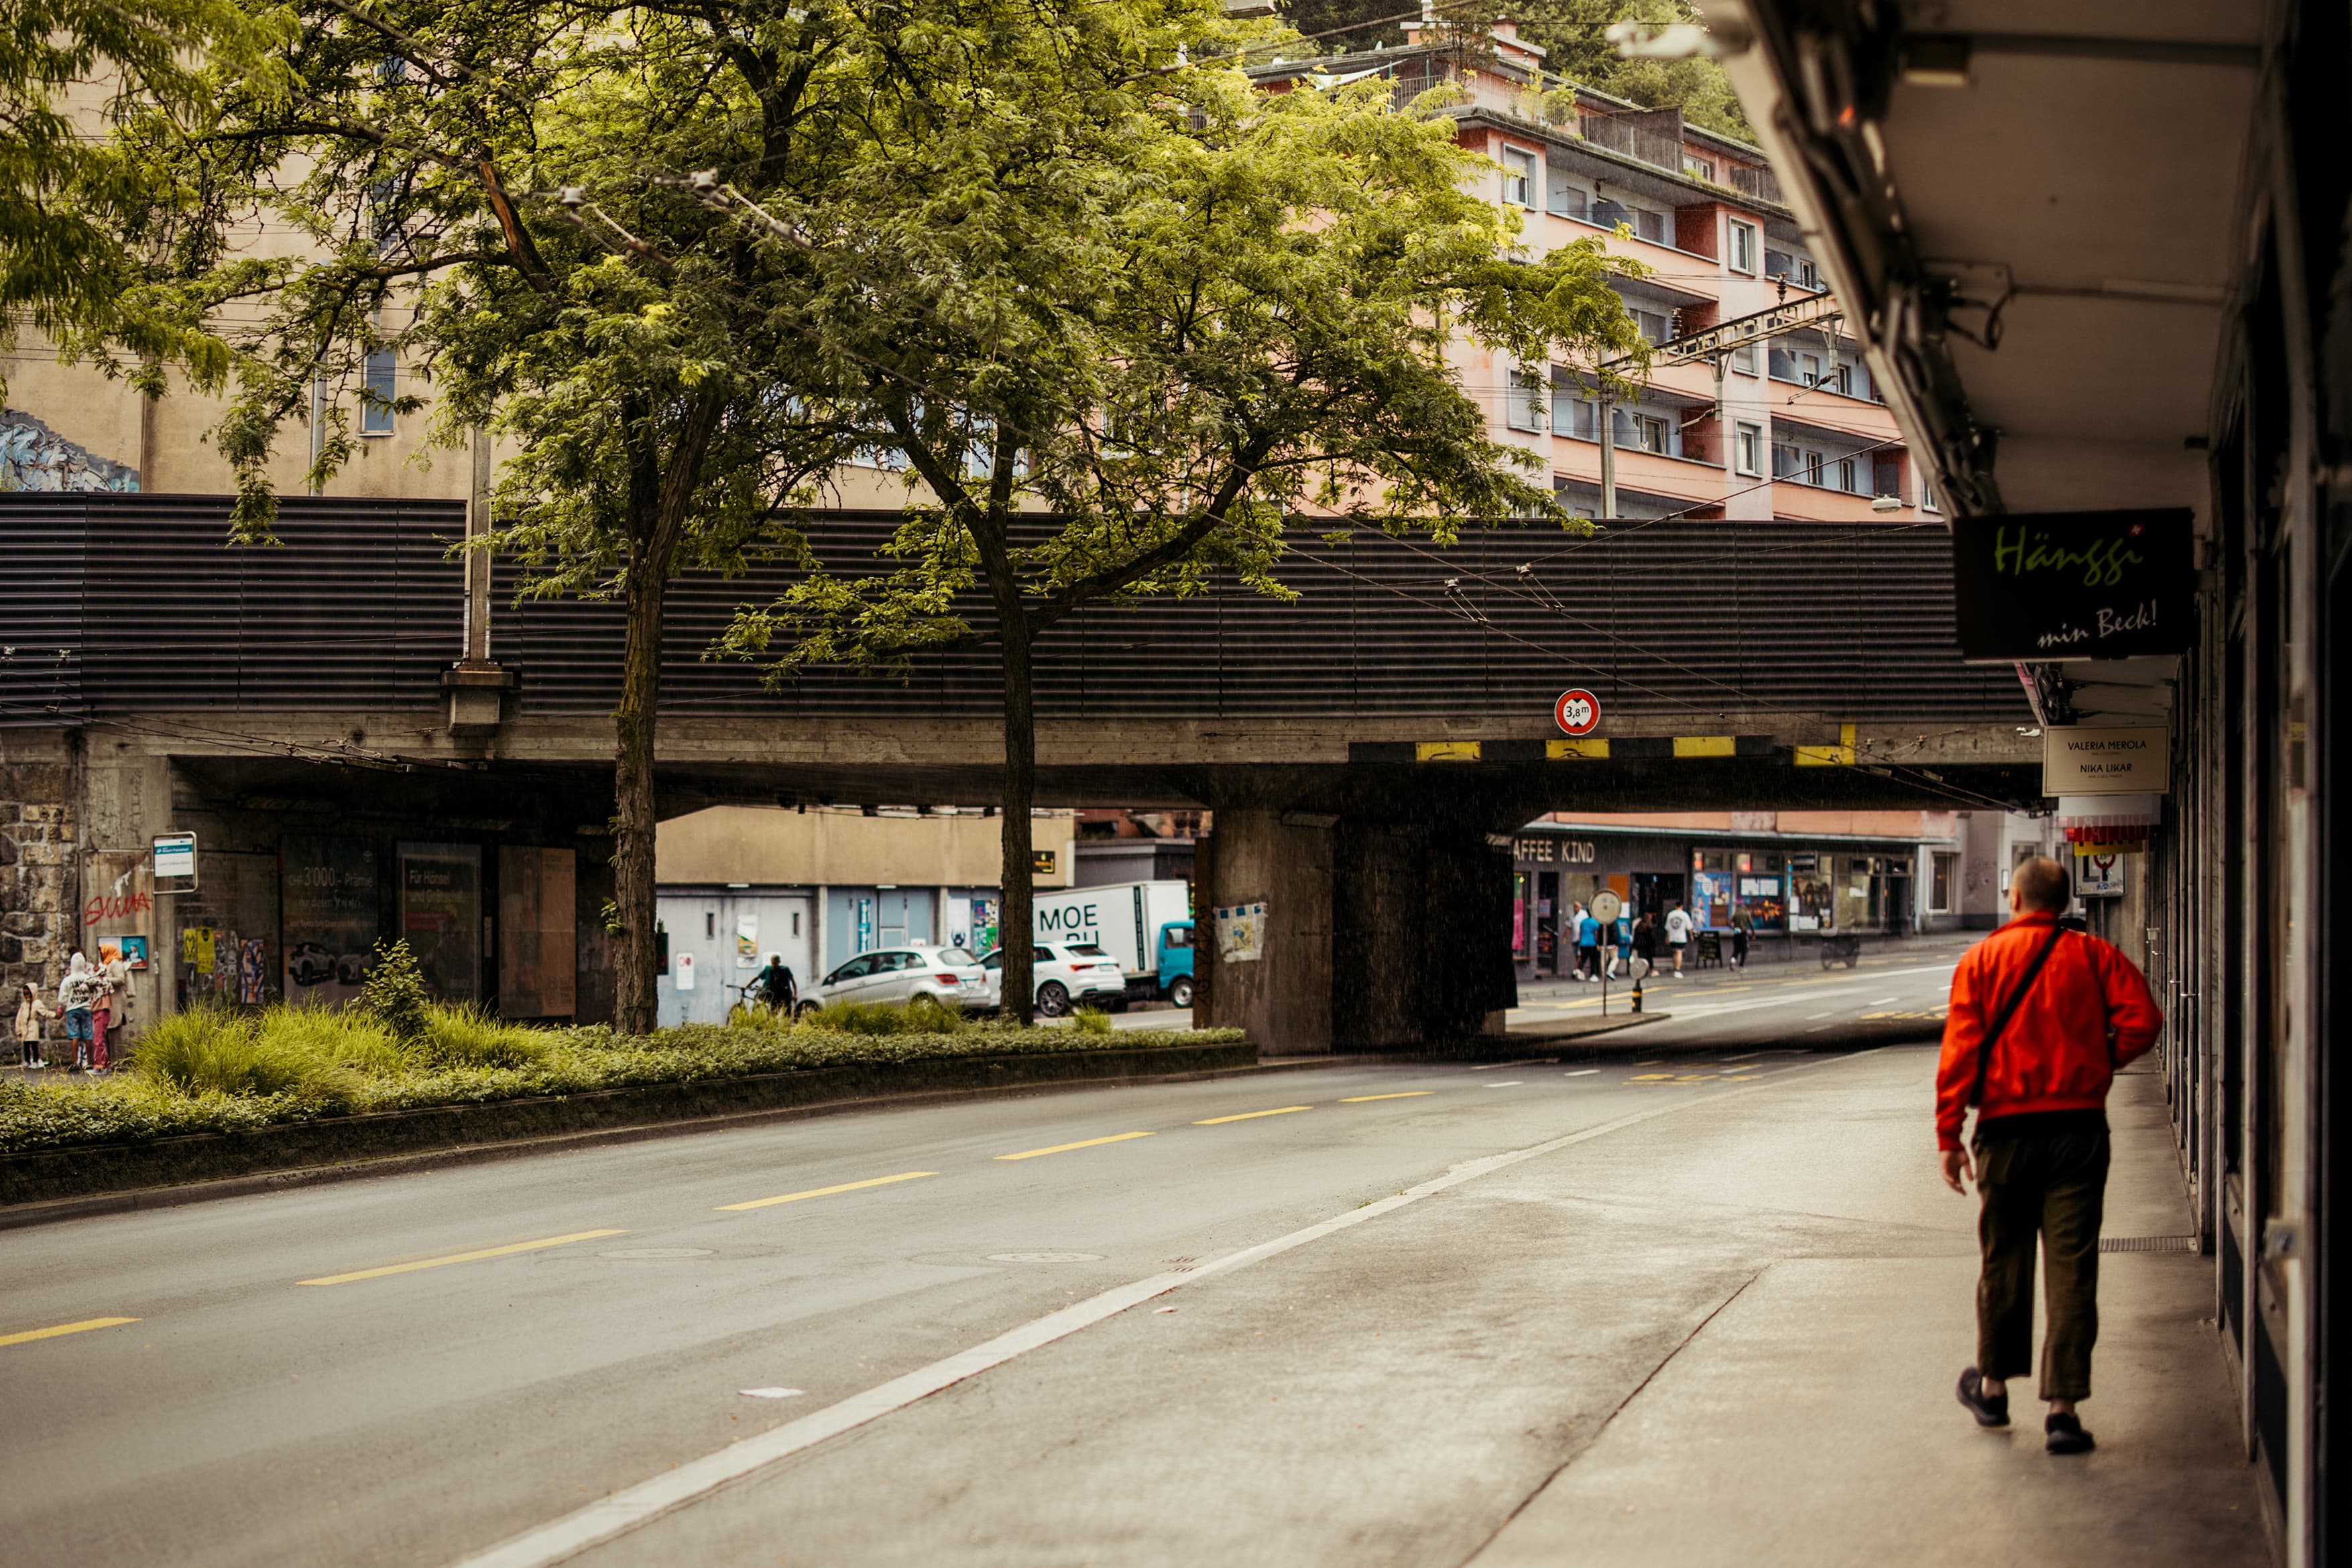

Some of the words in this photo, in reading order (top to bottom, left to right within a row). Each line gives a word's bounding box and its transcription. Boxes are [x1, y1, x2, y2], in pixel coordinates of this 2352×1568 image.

[1995, 525, 2143, 587] Hänggi
[2037, 623, 2090, 649] min
[2096, 597, 2157, 639] Beck!
[2068, 741, 2105, 751] VALERIA
[2107, 740, 2146, 750] MEROLA
[2080, 764, 2103, 773] NIKA
[2105, 763, 2133, 773] LIKAR
[1562, 841, 1595, 863] KIND
[345, 871, 373, 888] Prämie
[410, 869, 422, 884] Für
[424, 869, 451, 885] Hänsel
[1040, 904, 1098, 932] MOE
